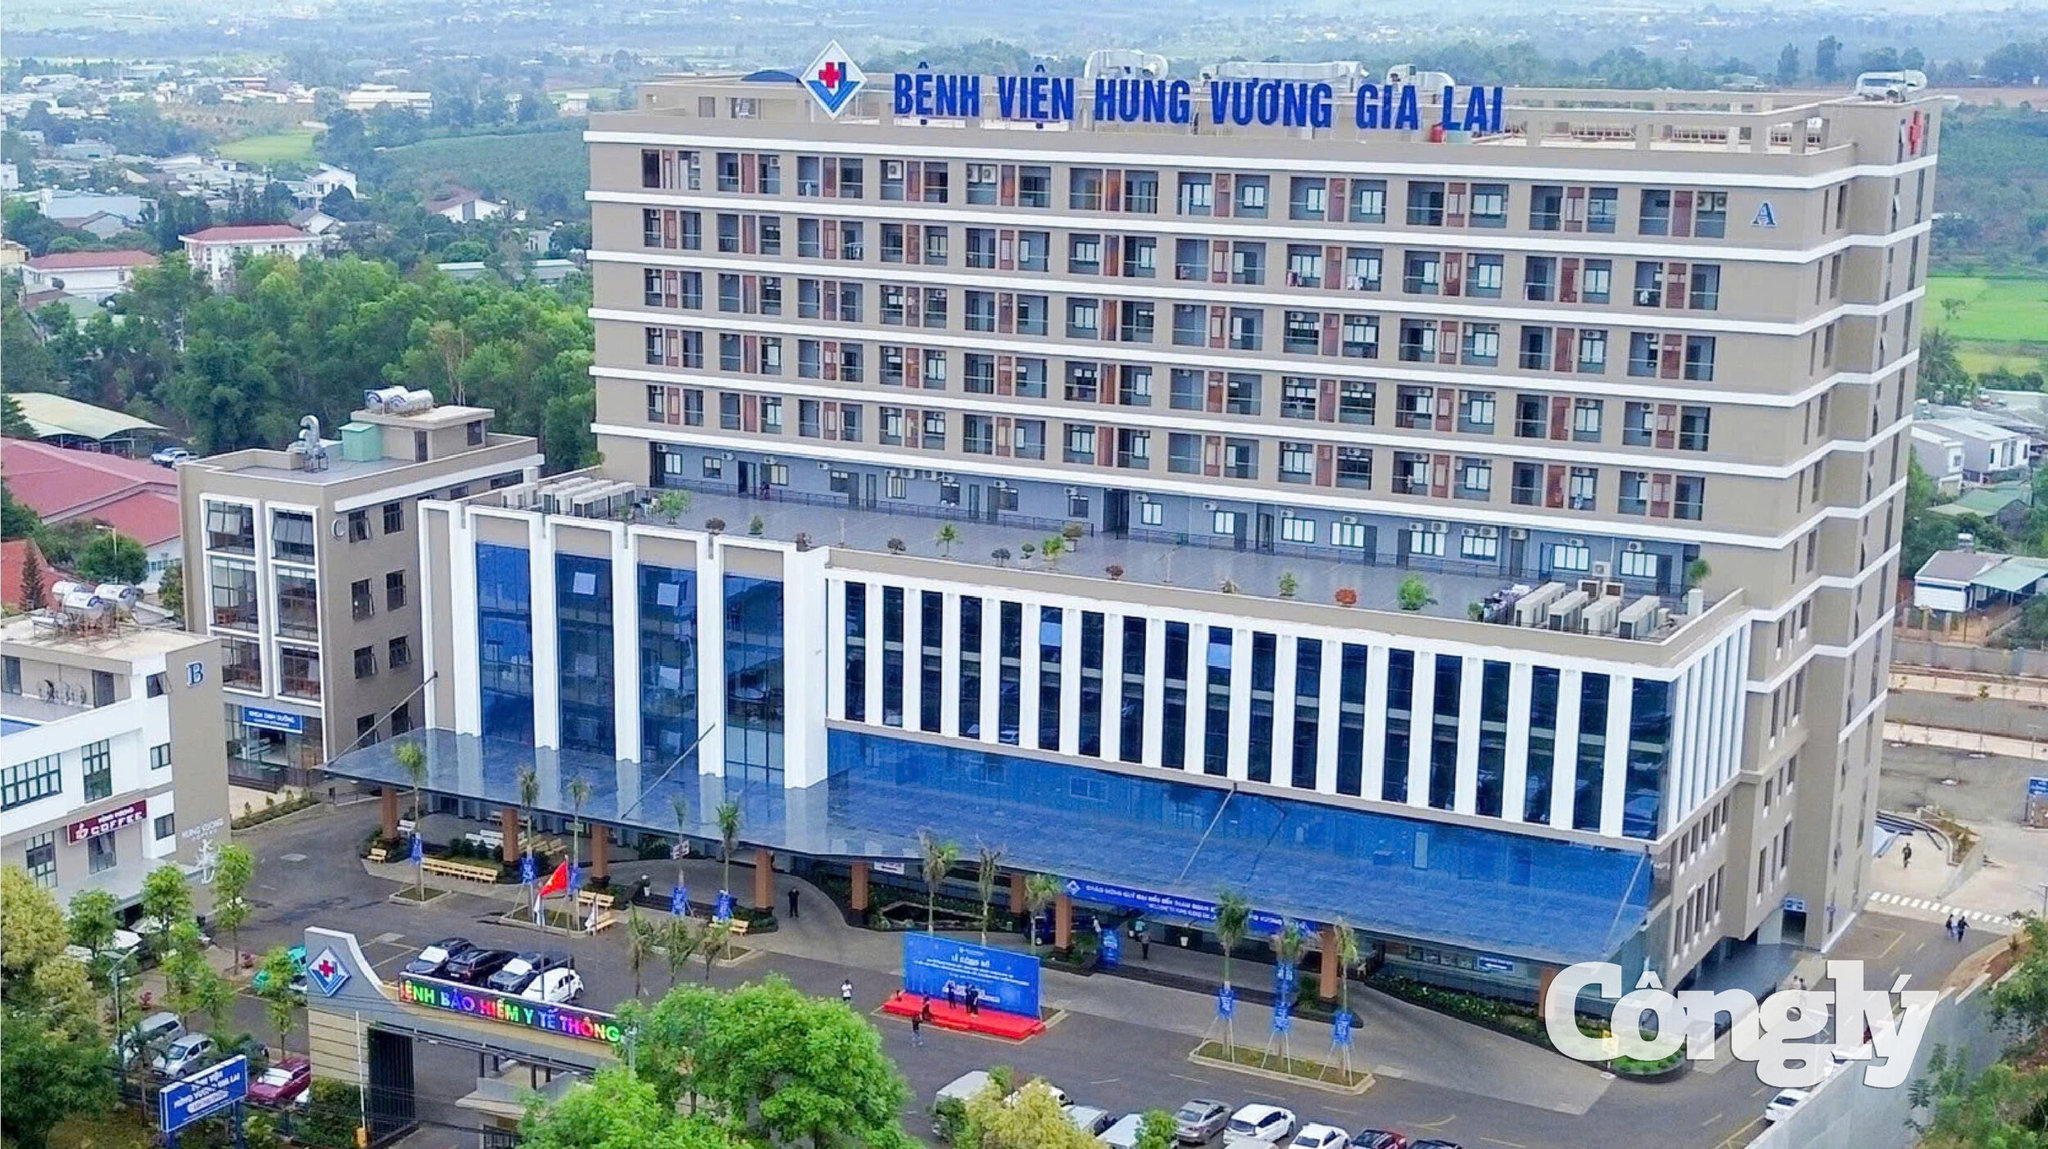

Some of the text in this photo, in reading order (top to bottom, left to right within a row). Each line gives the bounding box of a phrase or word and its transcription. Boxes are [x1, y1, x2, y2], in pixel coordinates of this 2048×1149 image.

[894, 61, 1504, 132] BỆNH VIỆN HÙNG VƯƠNG GIA LAI
[1751, 201, 1777, 226] A
[186, 661, 204, 687] B
[90, 811, 142, 835] COFFEE
[440, 988, 476, 1012] BẢO
[480, 998, 519, 1022] HIỂM
[523, 1007, 535, 1025] Y
[538, 1008, 559, 1029] TẾ
[559, 1016, 620, 1042] THÔNG
